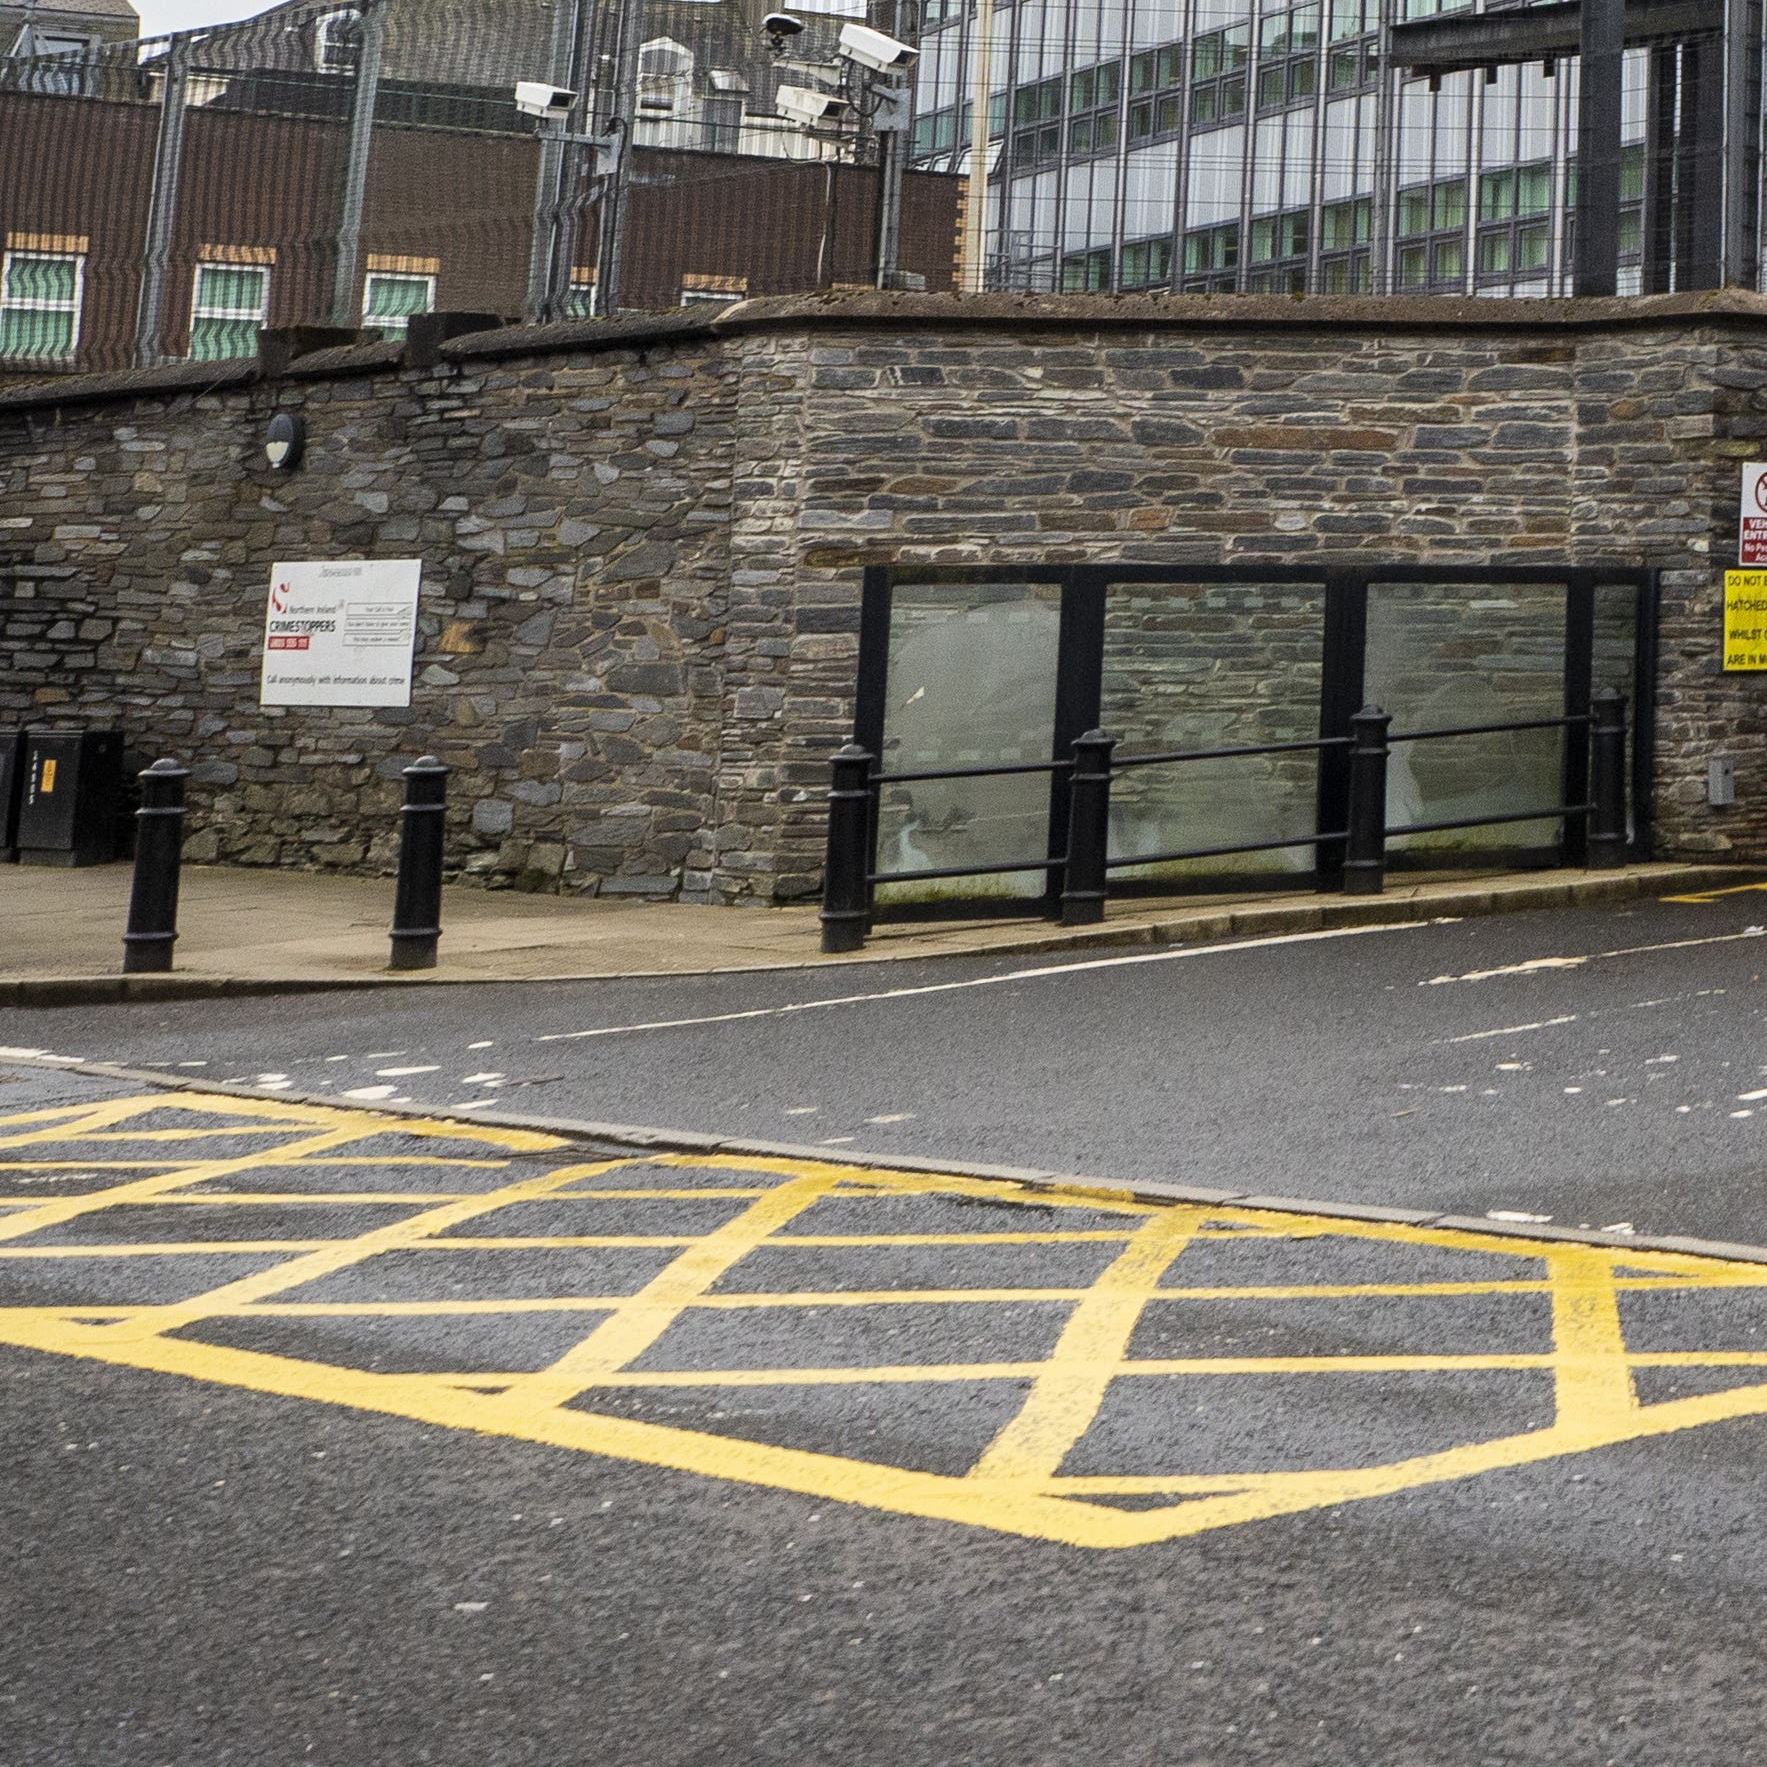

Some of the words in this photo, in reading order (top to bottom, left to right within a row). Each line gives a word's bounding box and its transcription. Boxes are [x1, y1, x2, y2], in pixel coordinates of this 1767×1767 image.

[1728, 575, 1741, 586] DO
[1744, 575, 1761, 586] NOT
[1727, 599, 1767, 611] HATCHED
[269, 620, 336, 633] CRIMESTOPPERS
[1730, 628, 1762, 640] WHILST
[1728, 654, 1746, 665] ARE
[1748, 654, 1757, 664] IN
